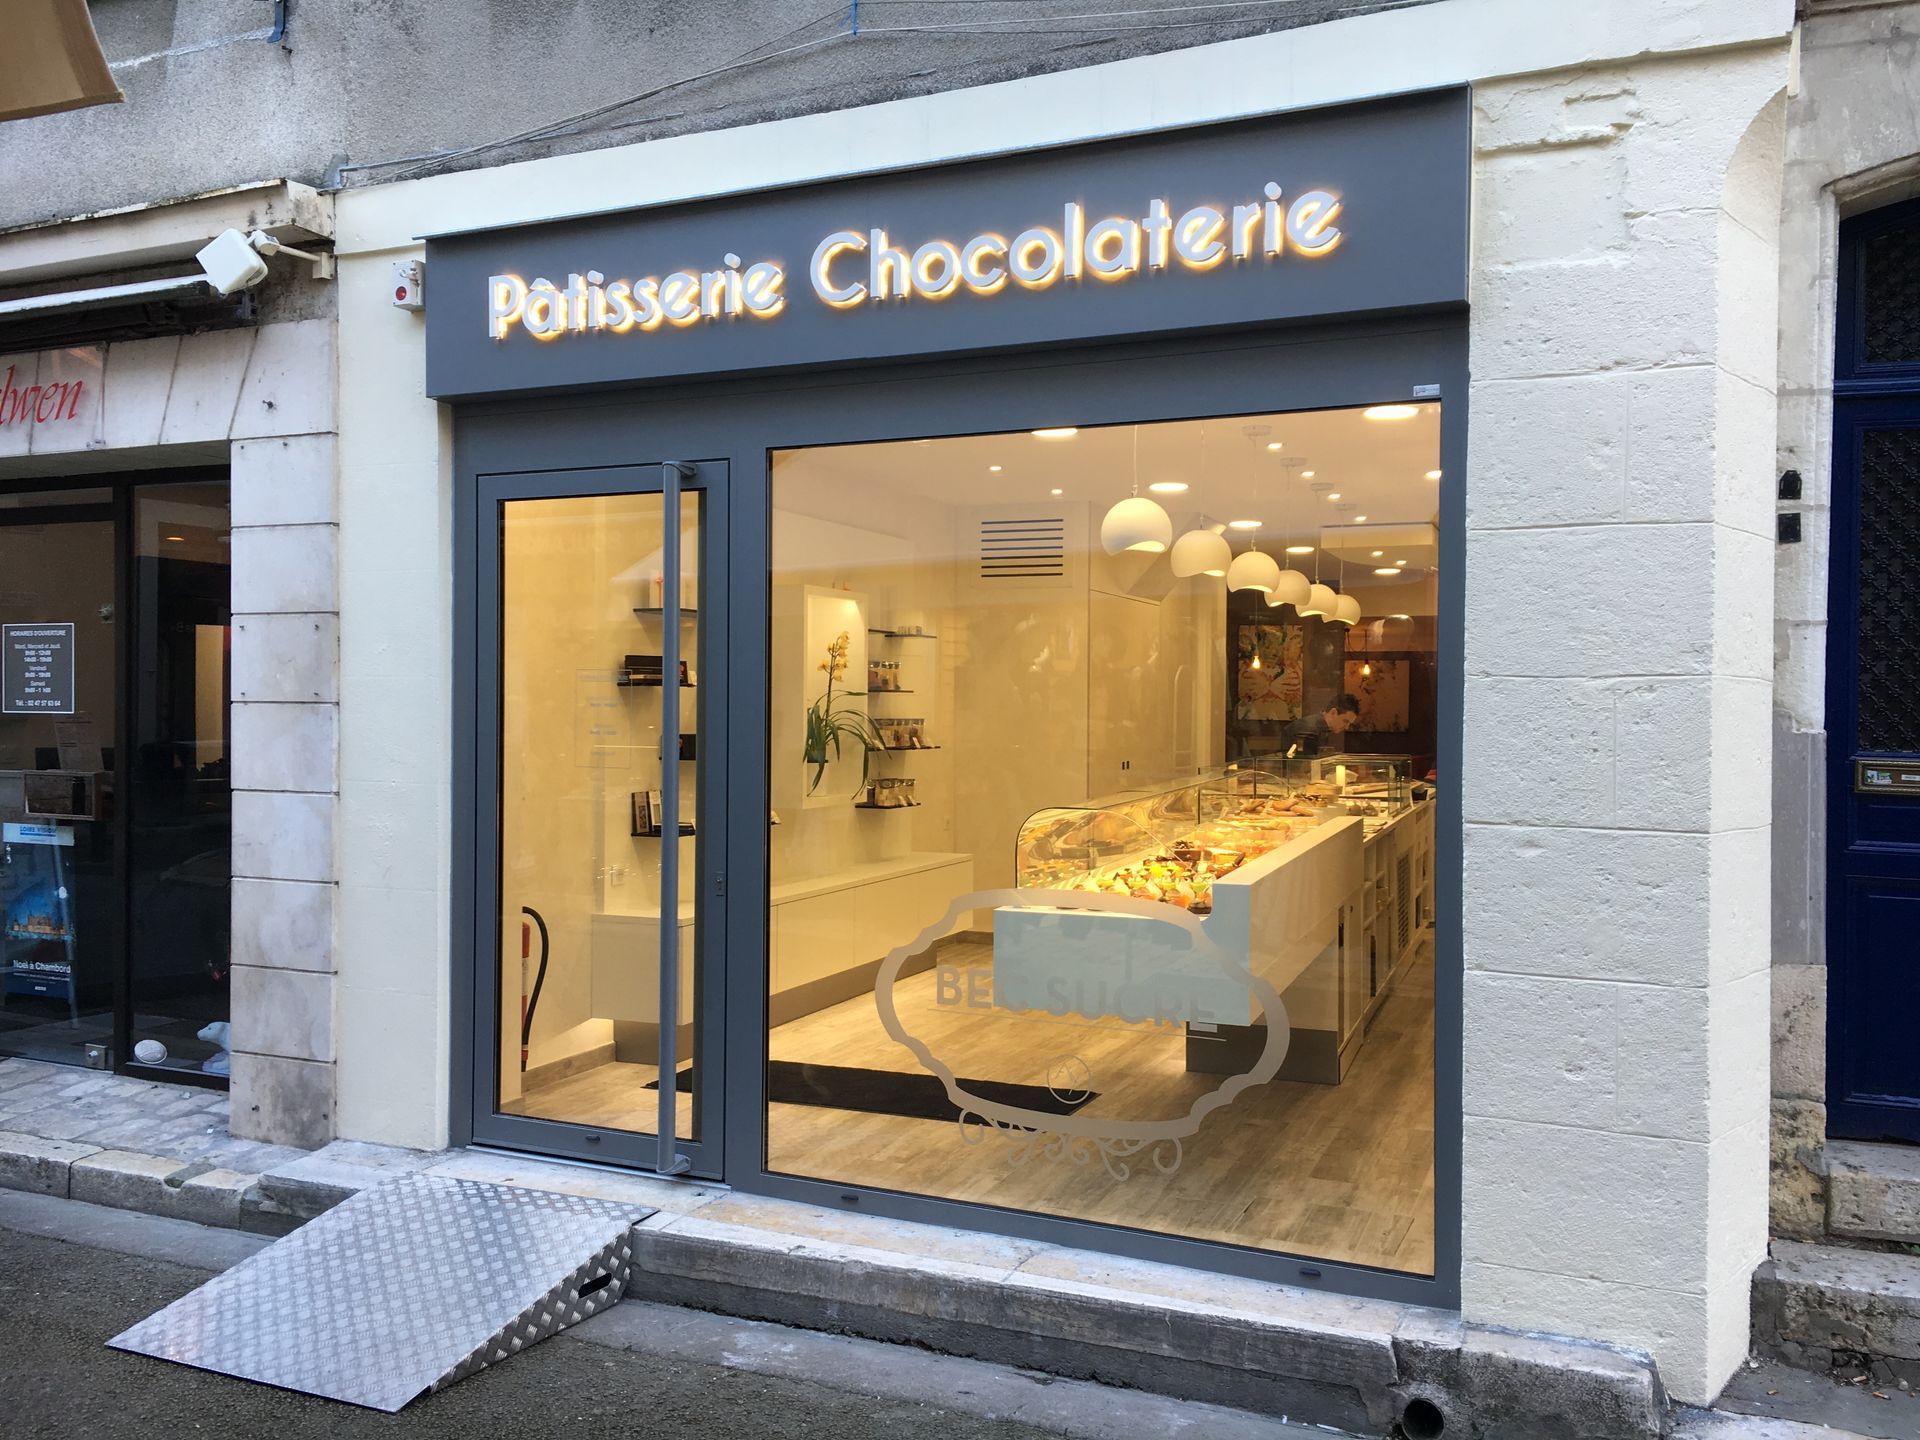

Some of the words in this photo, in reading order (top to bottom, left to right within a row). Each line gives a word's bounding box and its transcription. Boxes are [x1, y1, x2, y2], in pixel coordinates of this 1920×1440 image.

[488, 252, 785, 340] Pâtisserie
[809, 181, 1341, 303] Chocolaterie
[35, 962, 71, 974] Chambord
